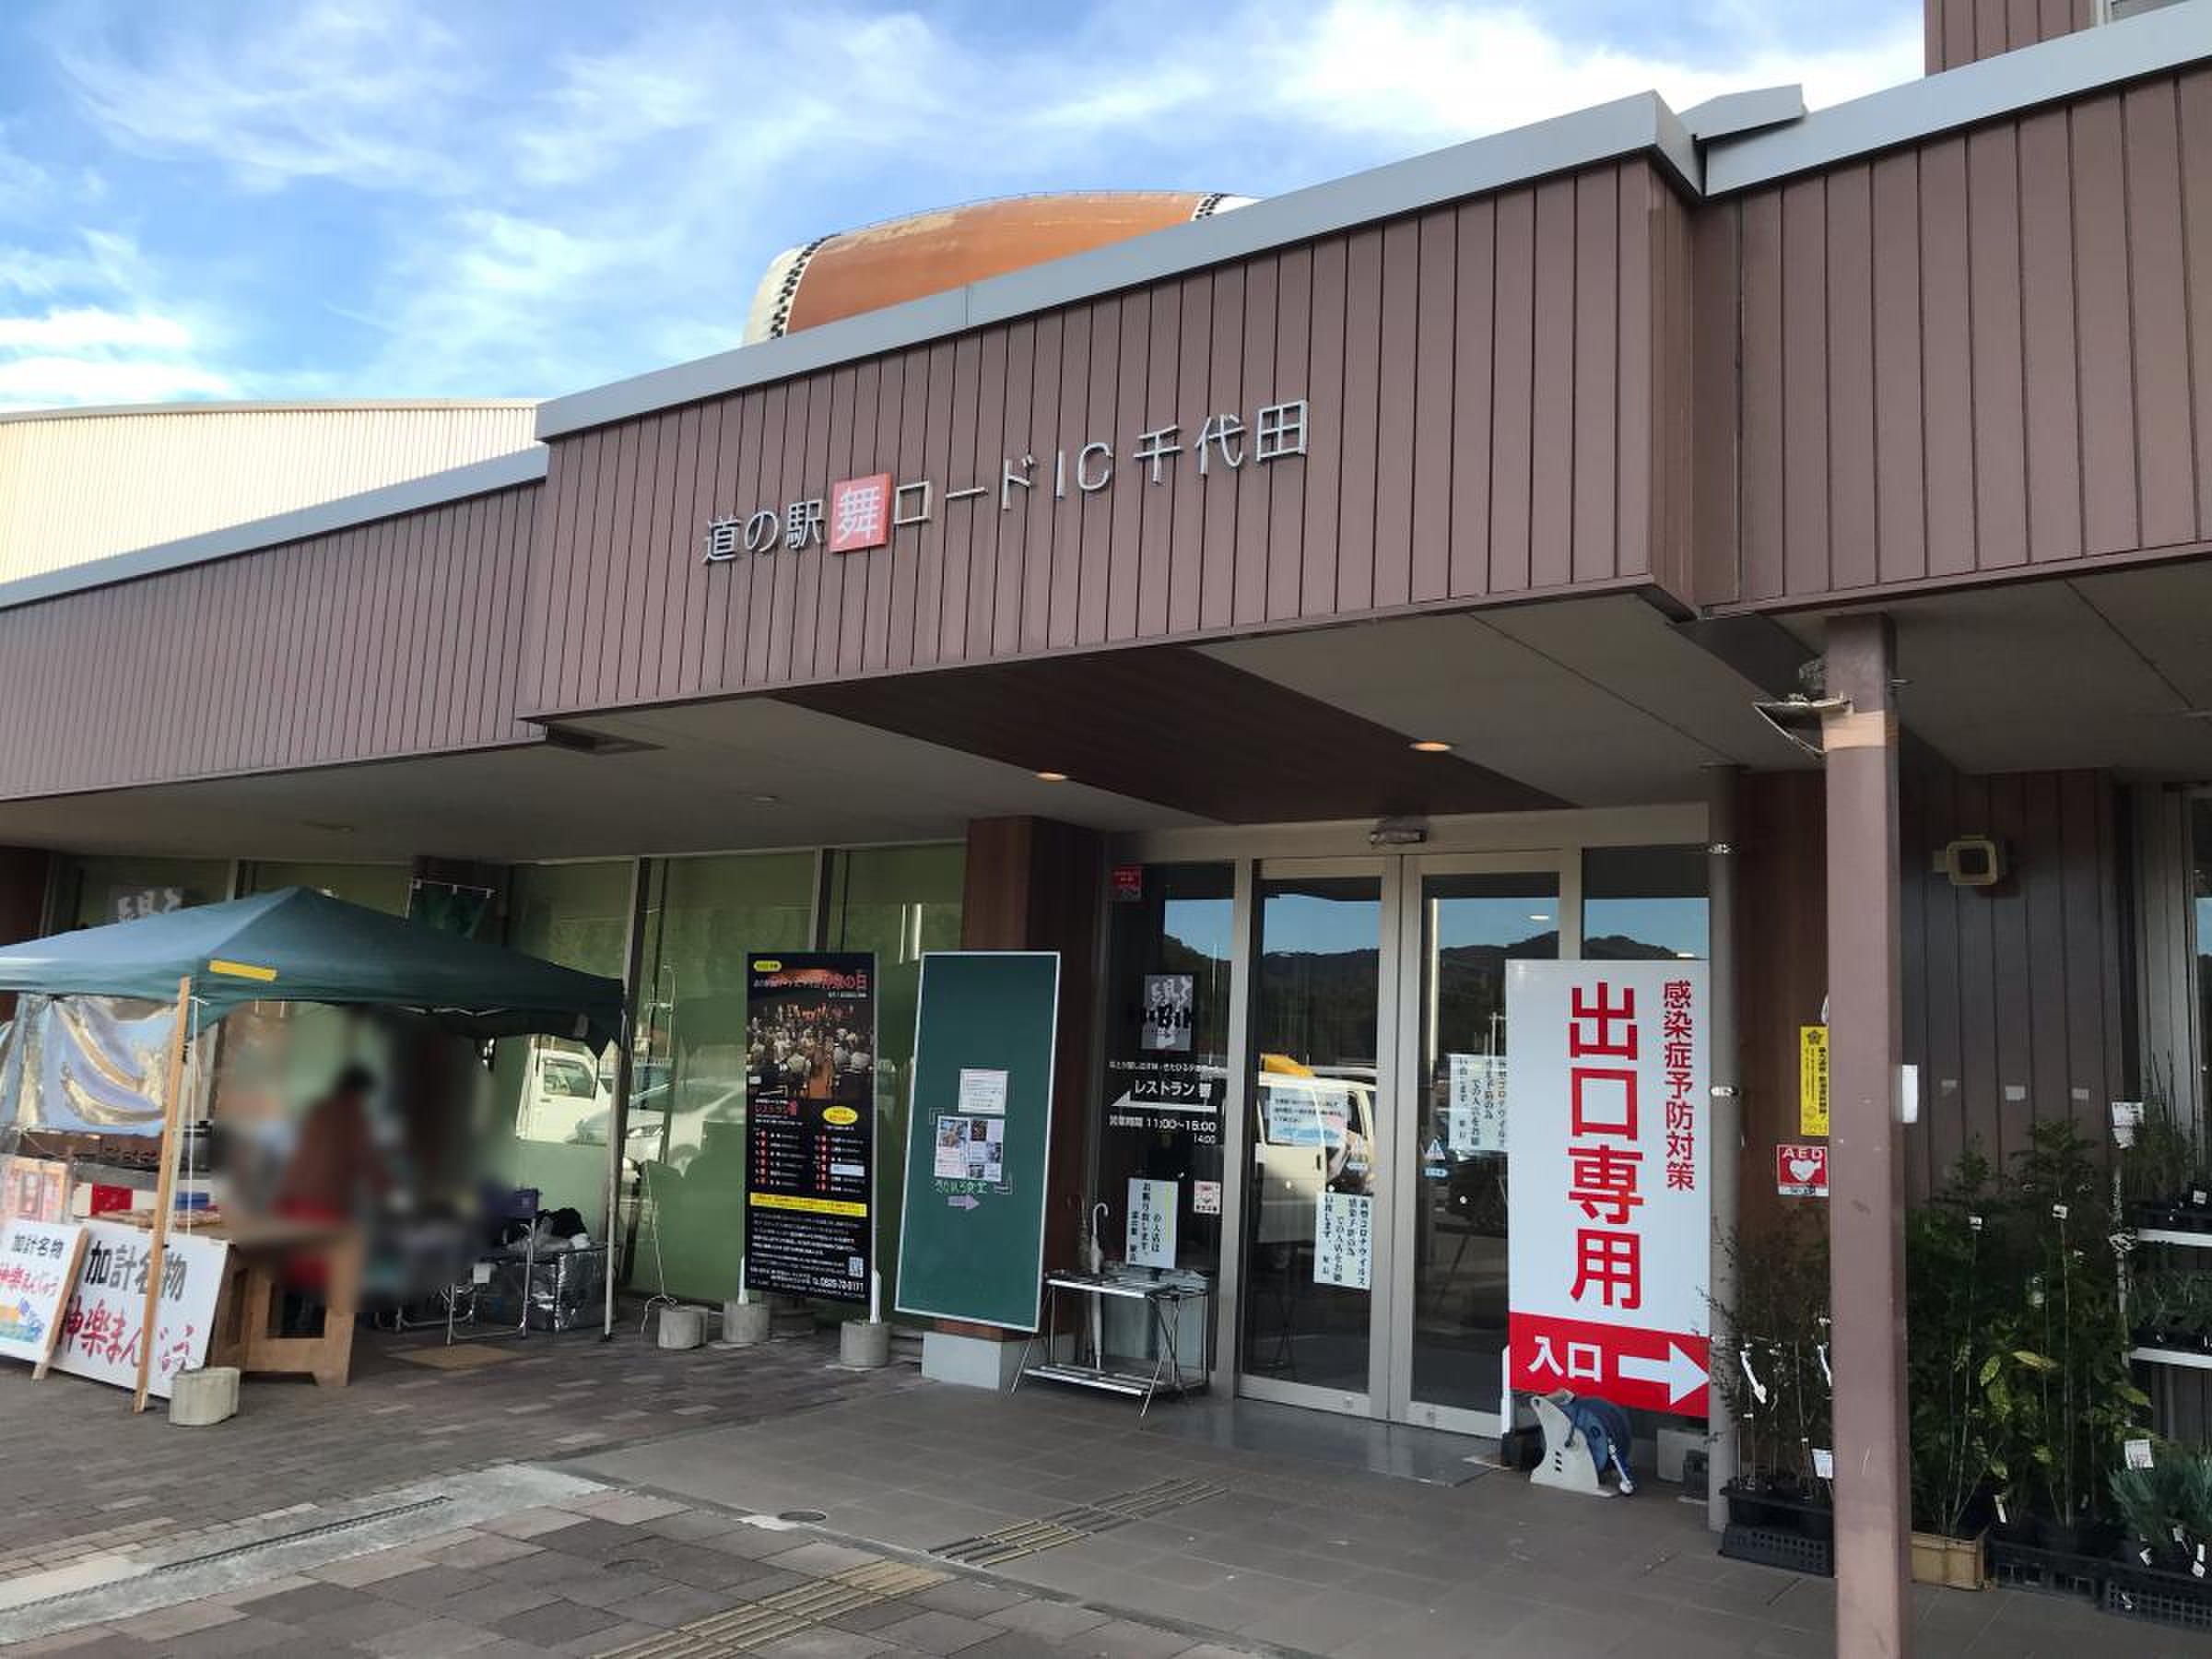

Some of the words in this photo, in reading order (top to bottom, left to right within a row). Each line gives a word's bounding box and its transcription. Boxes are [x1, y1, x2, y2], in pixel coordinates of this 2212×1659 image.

[1135, 1079, 1195, 1097] レストラン
[1664, 980, 1695, 1192] 感染症予防対策
[1568, 982, 1644, 1311] 出口専用
[1782, 1147, 1823, 1159] AED
[10, 1233, 64, 1260] 加計名物
[1527, 1335, 1603, 1382] 入口
